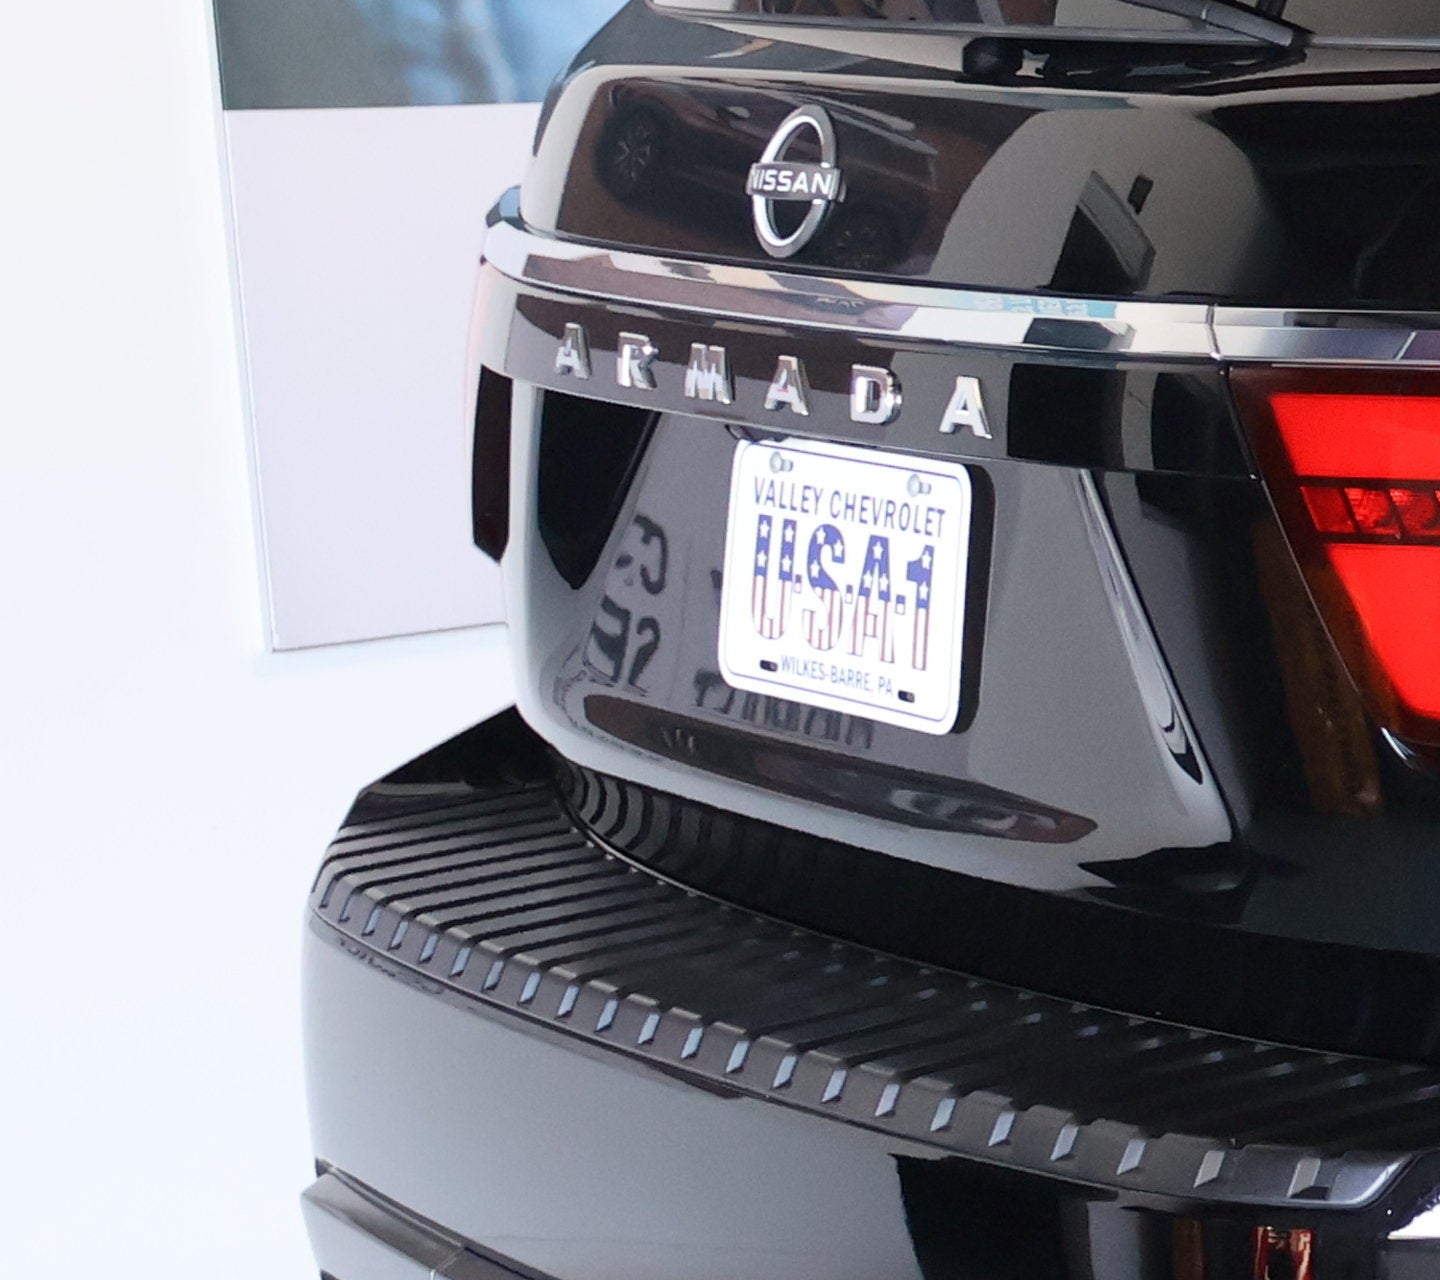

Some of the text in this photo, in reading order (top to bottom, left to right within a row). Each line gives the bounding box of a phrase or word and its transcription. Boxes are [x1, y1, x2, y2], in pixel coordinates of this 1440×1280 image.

[751, 169, 832, 195] NISSAN
[554, 322, 993, 439] ARMADA
[754, 476, 946, 538] VALLEY CHEVROLET
[877, 677, 893, 696] PA
